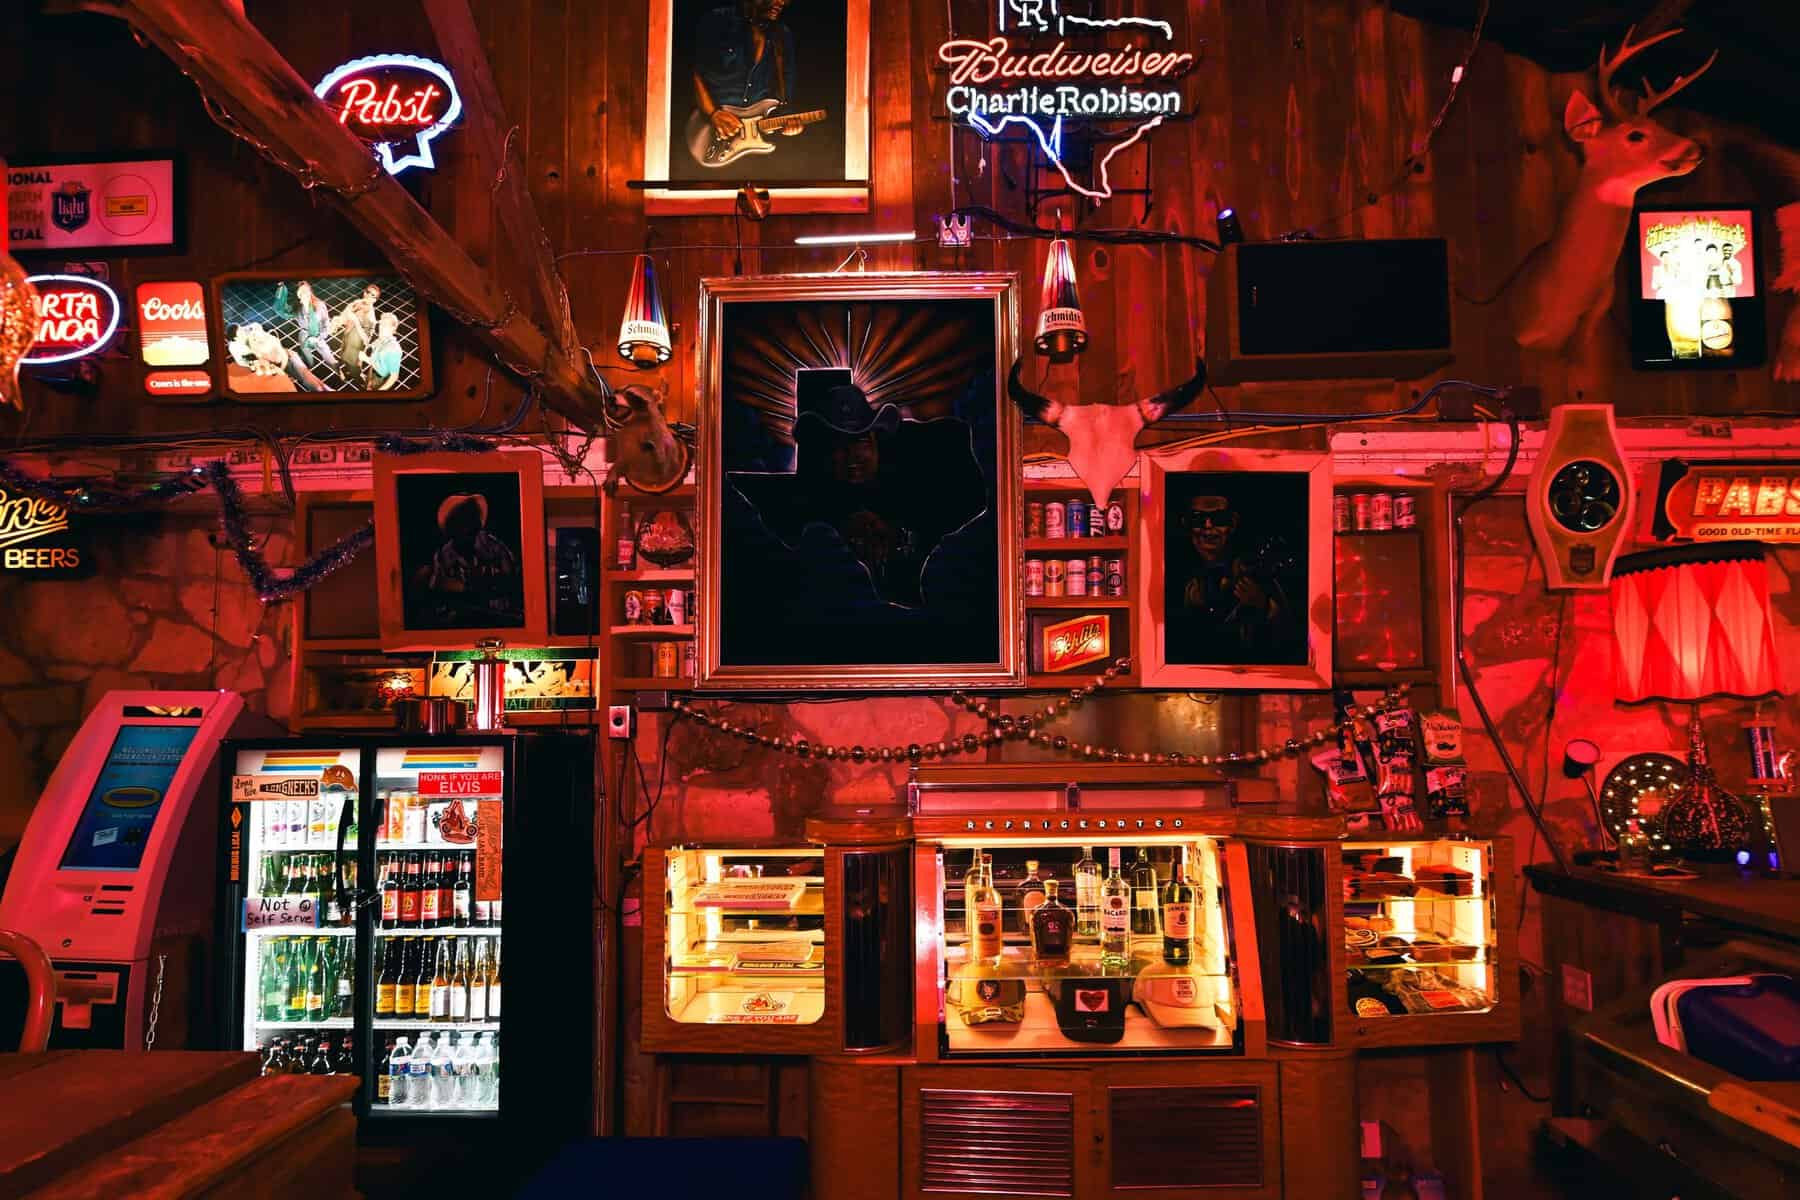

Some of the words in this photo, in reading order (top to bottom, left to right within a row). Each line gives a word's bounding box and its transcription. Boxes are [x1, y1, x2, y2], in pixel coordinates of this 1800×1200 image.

[939, 37, 1193, 84] Budweiser
[340, 80, 440, 124] Pabst
[1056, 86, 1181, 113] Robison
[142, 297, 205, 320] Coors
[1698, 528, 1728, 536] GOOD
[1731, 528, 1782, 536] OLD-TIME
[1785, 528, 1800, 536] FL
[4, 548, 80, 569] BEERS
[461, 773, 479, 781] YOU
[481, 772, 501, 780] ARE
[440, 781, 481, 793] ELVIS
[966, 820, 1184, 830] REFRIGERATED
[260, 898, 290, 912] Not
[247, 912, 276, 925] Self
[279, 912, 313, 924] Serve
